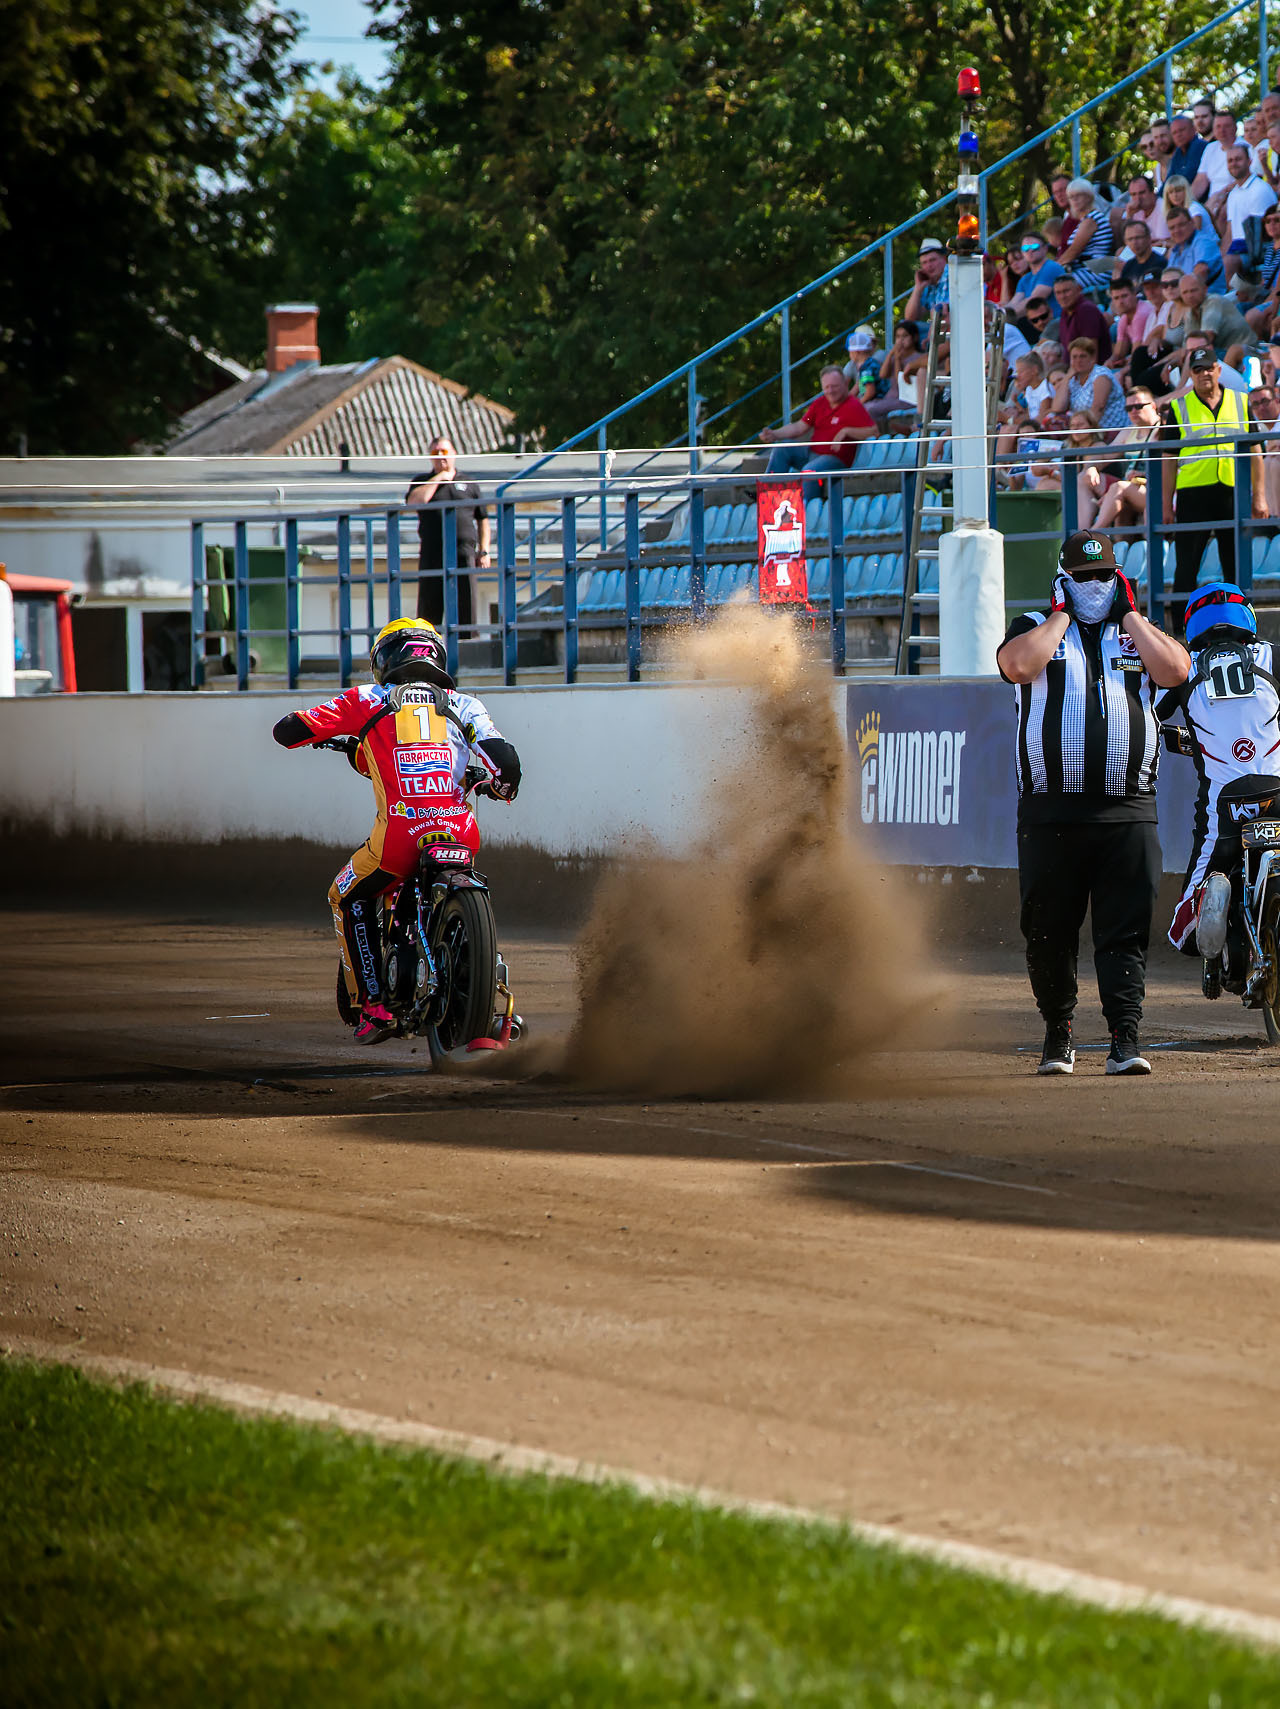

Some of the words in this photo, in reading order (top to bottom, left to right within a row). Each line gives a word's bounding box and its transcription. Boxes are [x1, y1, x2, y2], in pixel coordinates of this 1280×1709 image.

[1210, 661, 1256, 697] 10
[413, 706, 431, 740] 1
[400, 751, 450, 764] ABRAMCZYK
[401, 776, 453, 794] TEAM
[408, 820, 436, 836] Nowak
[437, 818, 461, 832] GmbH
